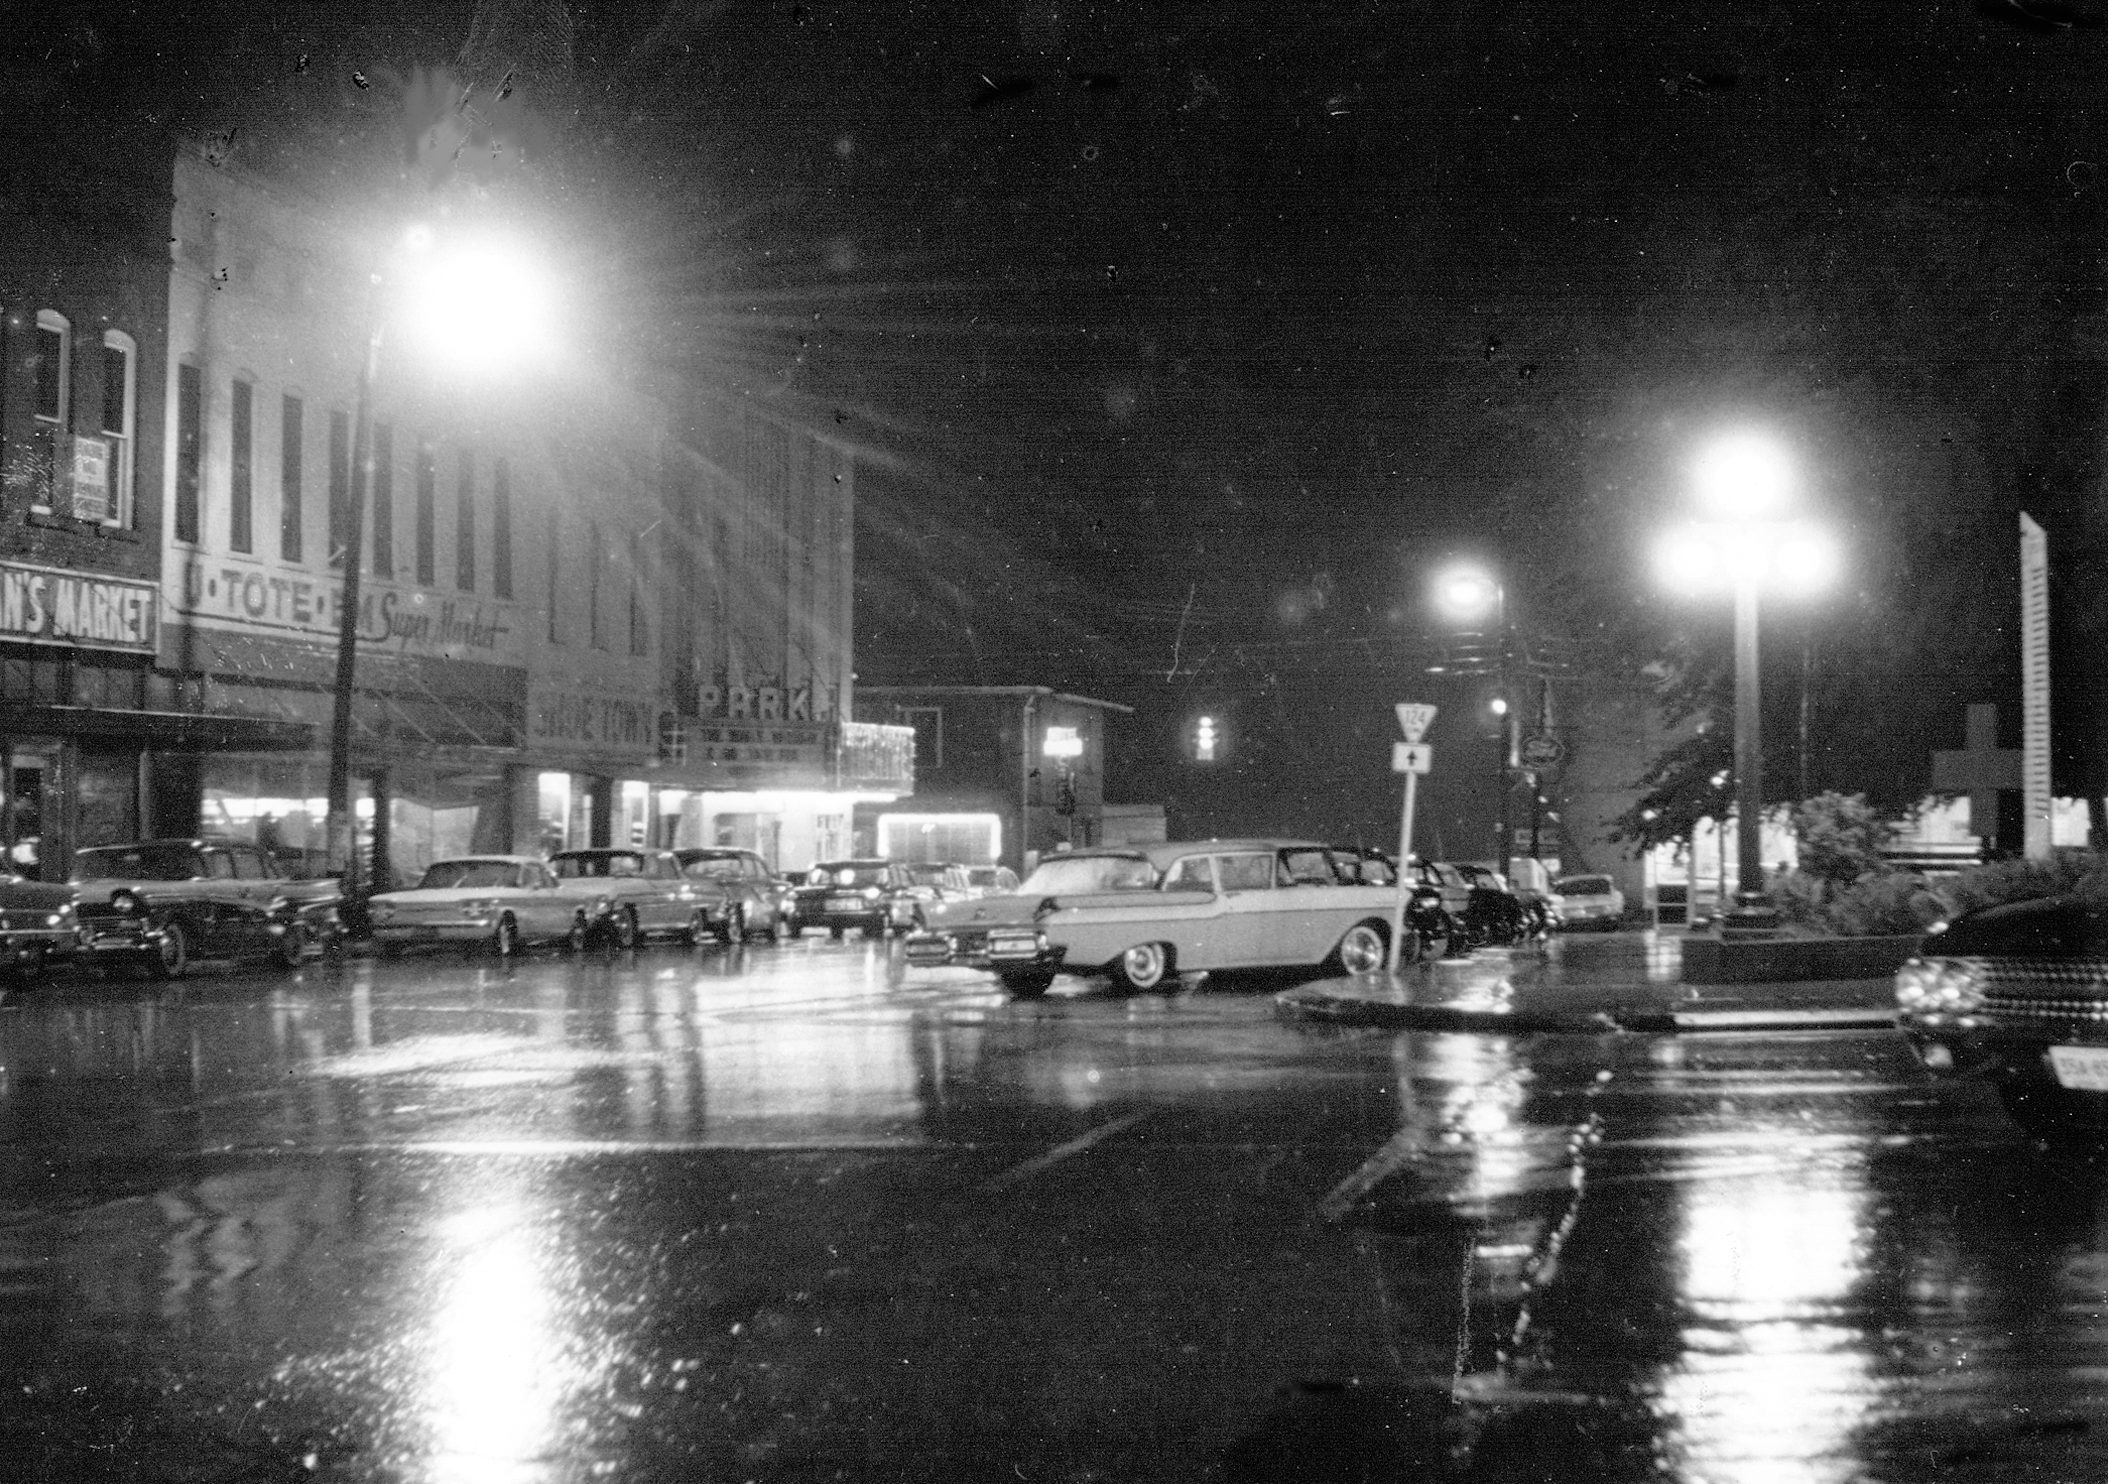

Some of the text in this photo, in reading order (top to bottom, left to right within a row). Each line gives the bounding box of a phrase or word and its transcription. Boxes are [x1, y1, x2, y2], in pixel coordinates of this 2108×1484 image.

[0, 571, 151, 643] N'S MARKET
[699, 684, 811, 721] PARK
